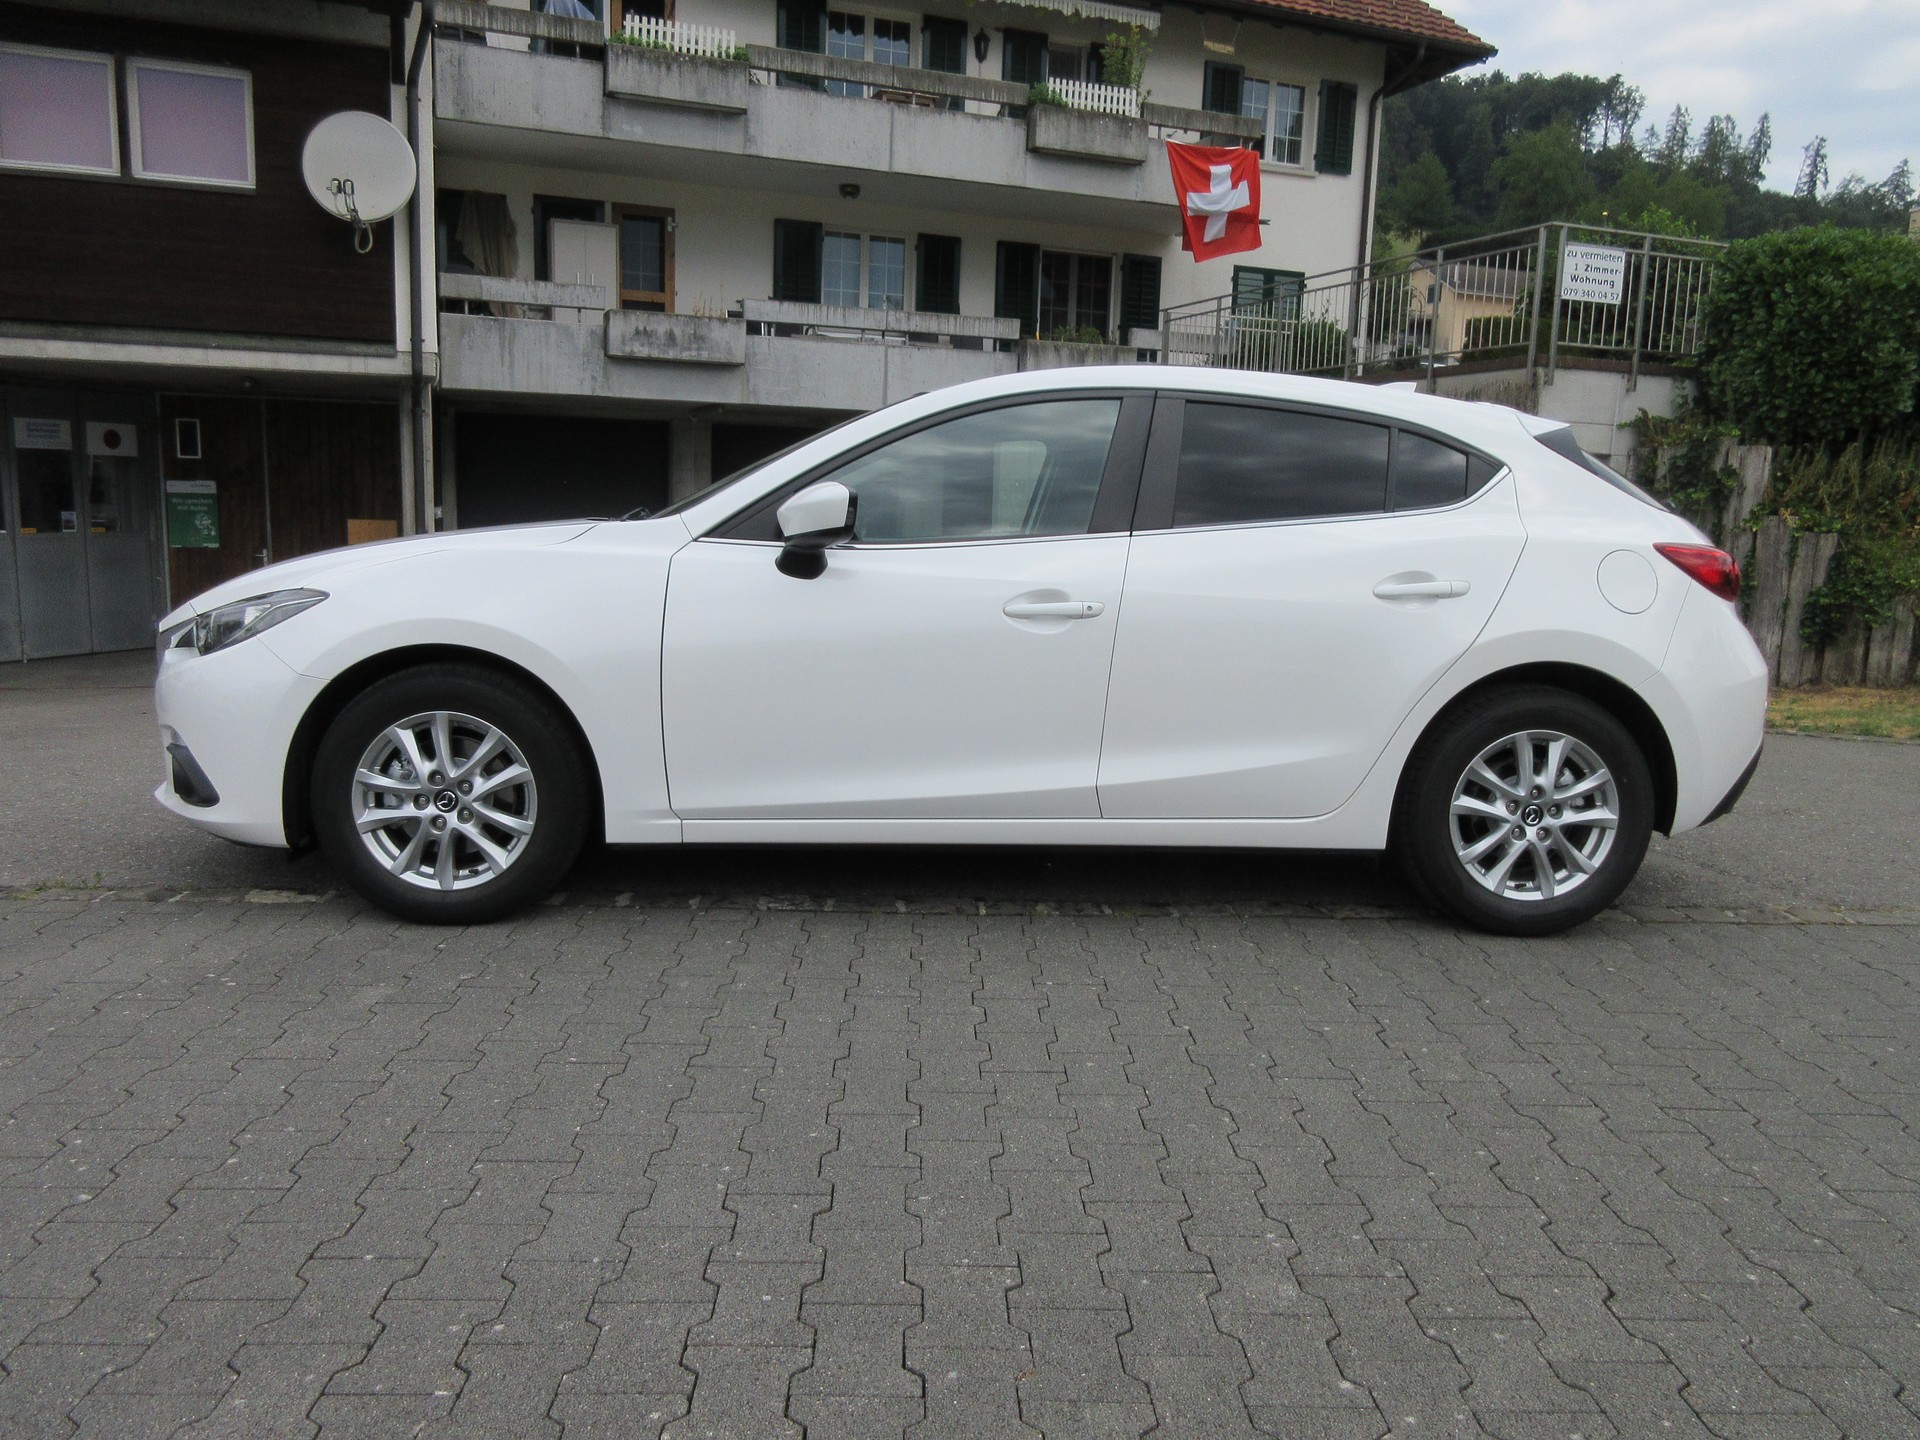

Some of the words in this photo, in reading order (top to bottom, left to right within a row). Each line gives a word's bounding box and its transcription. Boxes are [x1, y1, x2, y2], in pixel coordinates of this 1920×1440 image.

[1566, 250, 1578, 258] zu
[1580, 251, 1623, 263] vermieten
[1584, 263, 1622, 275] Zimmer-
[1570, 274, 1615, 289] Wohnung
[1563, 288, 1578, 297] 079
[1580, 289, 1596, 298] 340
[1597, 291, 1608, 299] 04
[1610, 292, 1620, 301] 57
